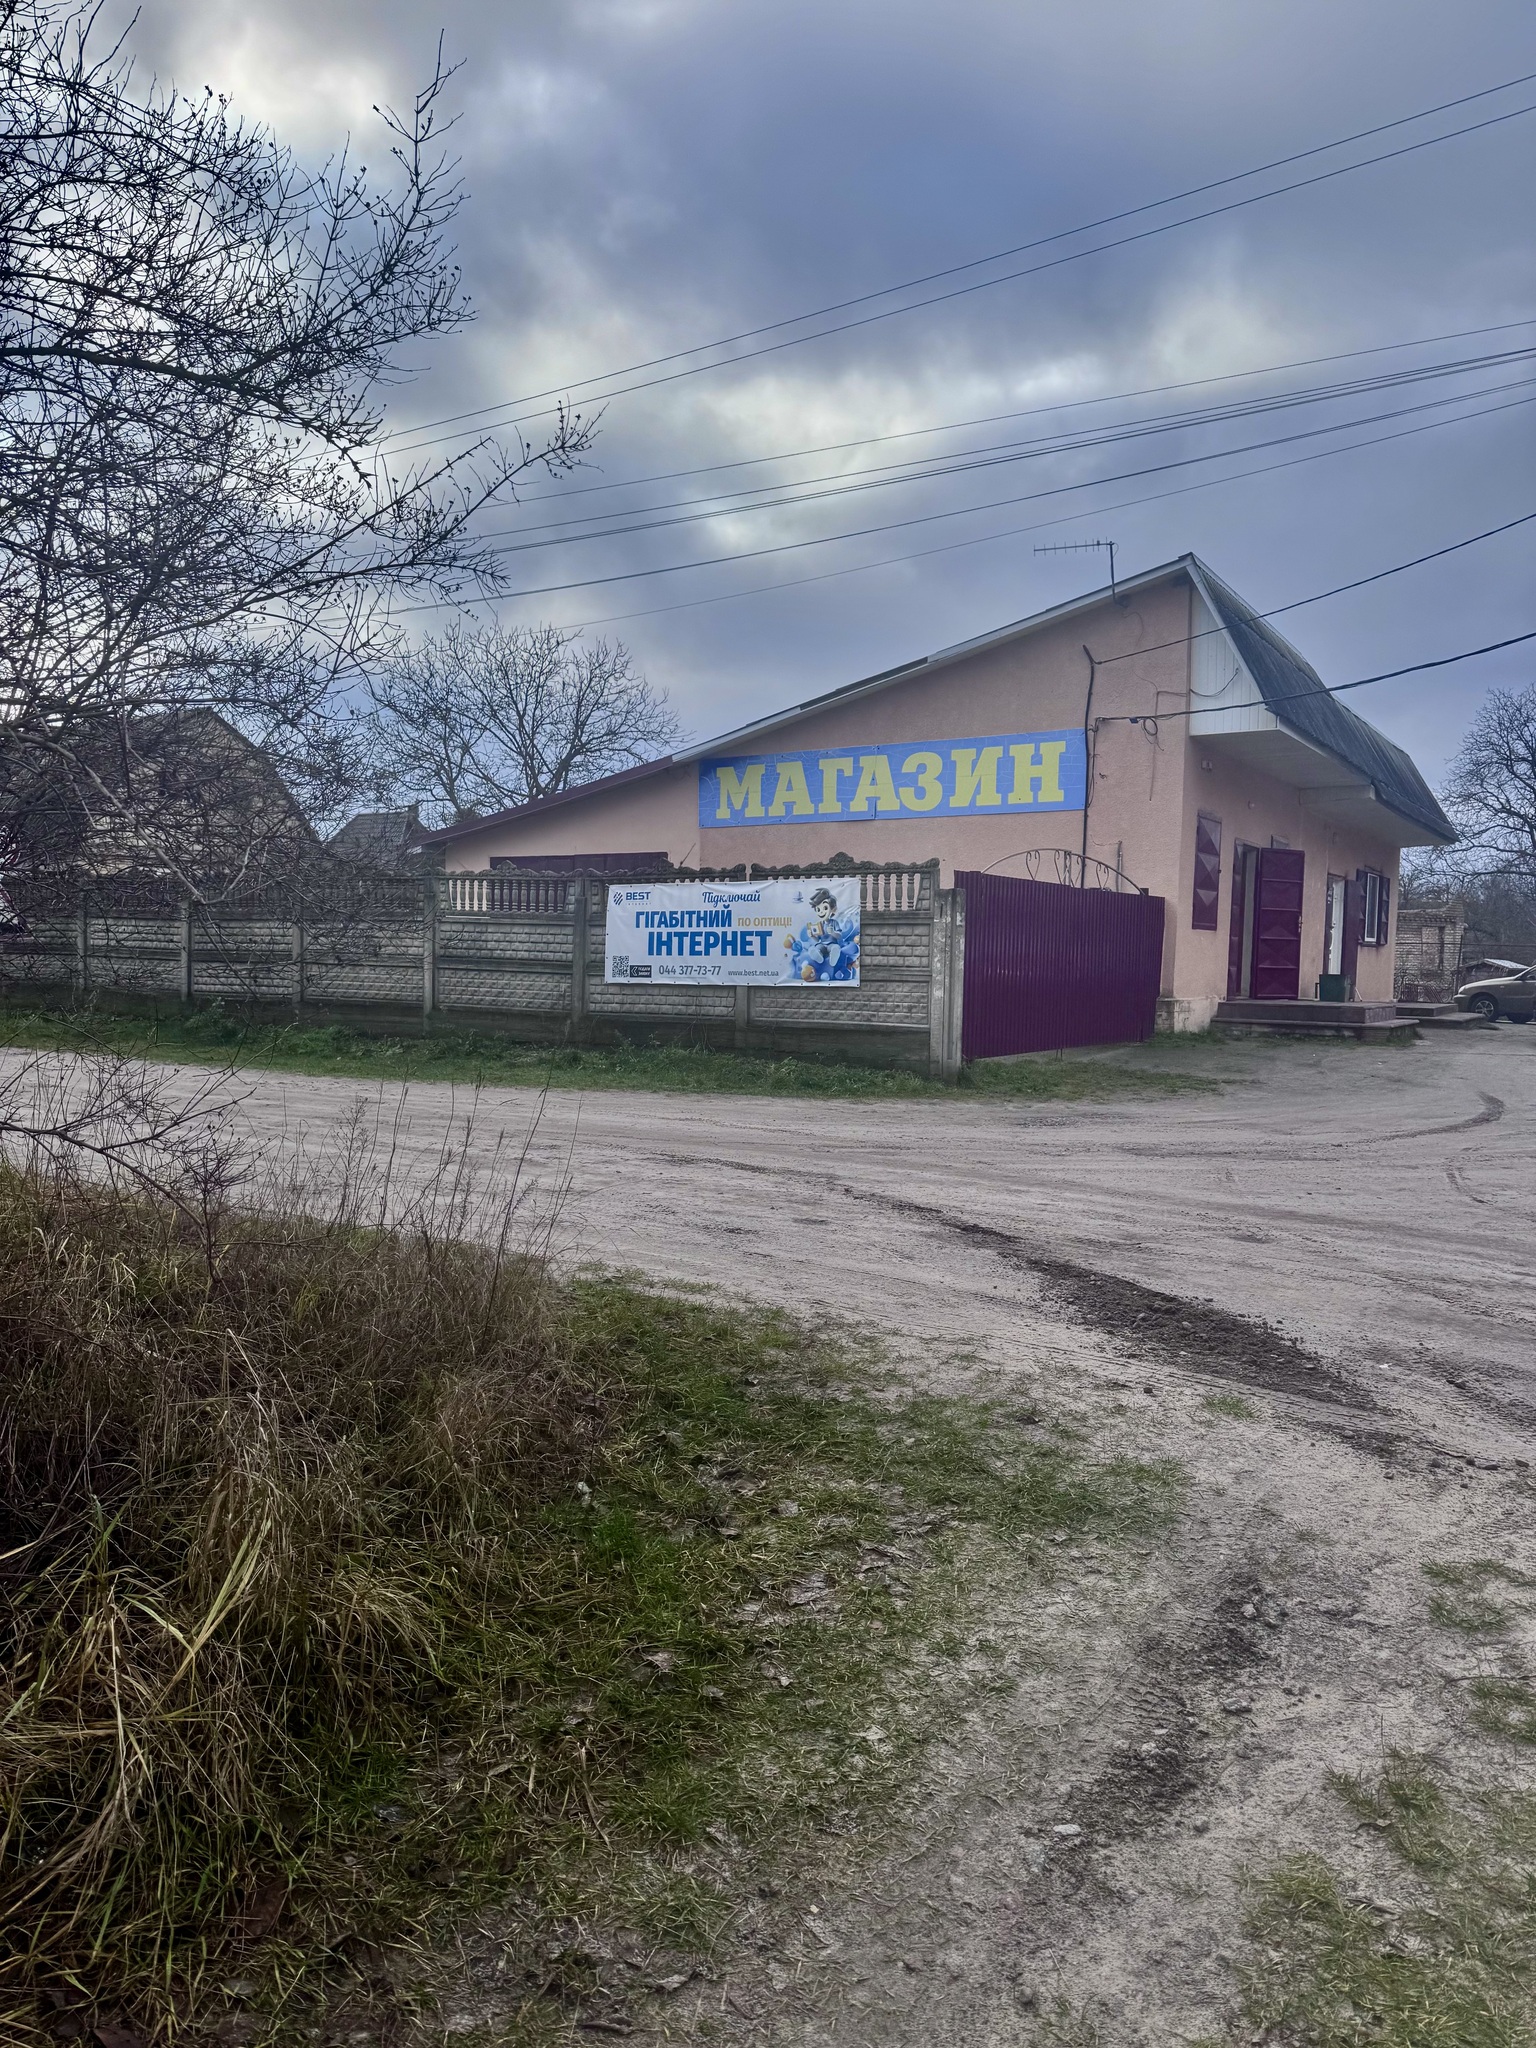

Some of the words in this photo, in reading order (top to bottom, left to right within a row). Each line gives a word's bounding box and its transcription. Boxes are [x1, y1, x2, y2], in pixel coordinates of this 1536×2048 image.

[716, 741, 1066, 819] МАГАЗИН
[626, 892, 651, 900] BEST
[702, 890, 761, 908] Підключай
[635, 904, 732, 928] ГІГАБІТНИЙ
[648, 931, 772, 957] ІНТЕРНЕТ
[658, 965, 676, 975] 044
[678, 965, 721, 976] 377-73-77
[728, 968, 779, 977] www.best.net.ua
